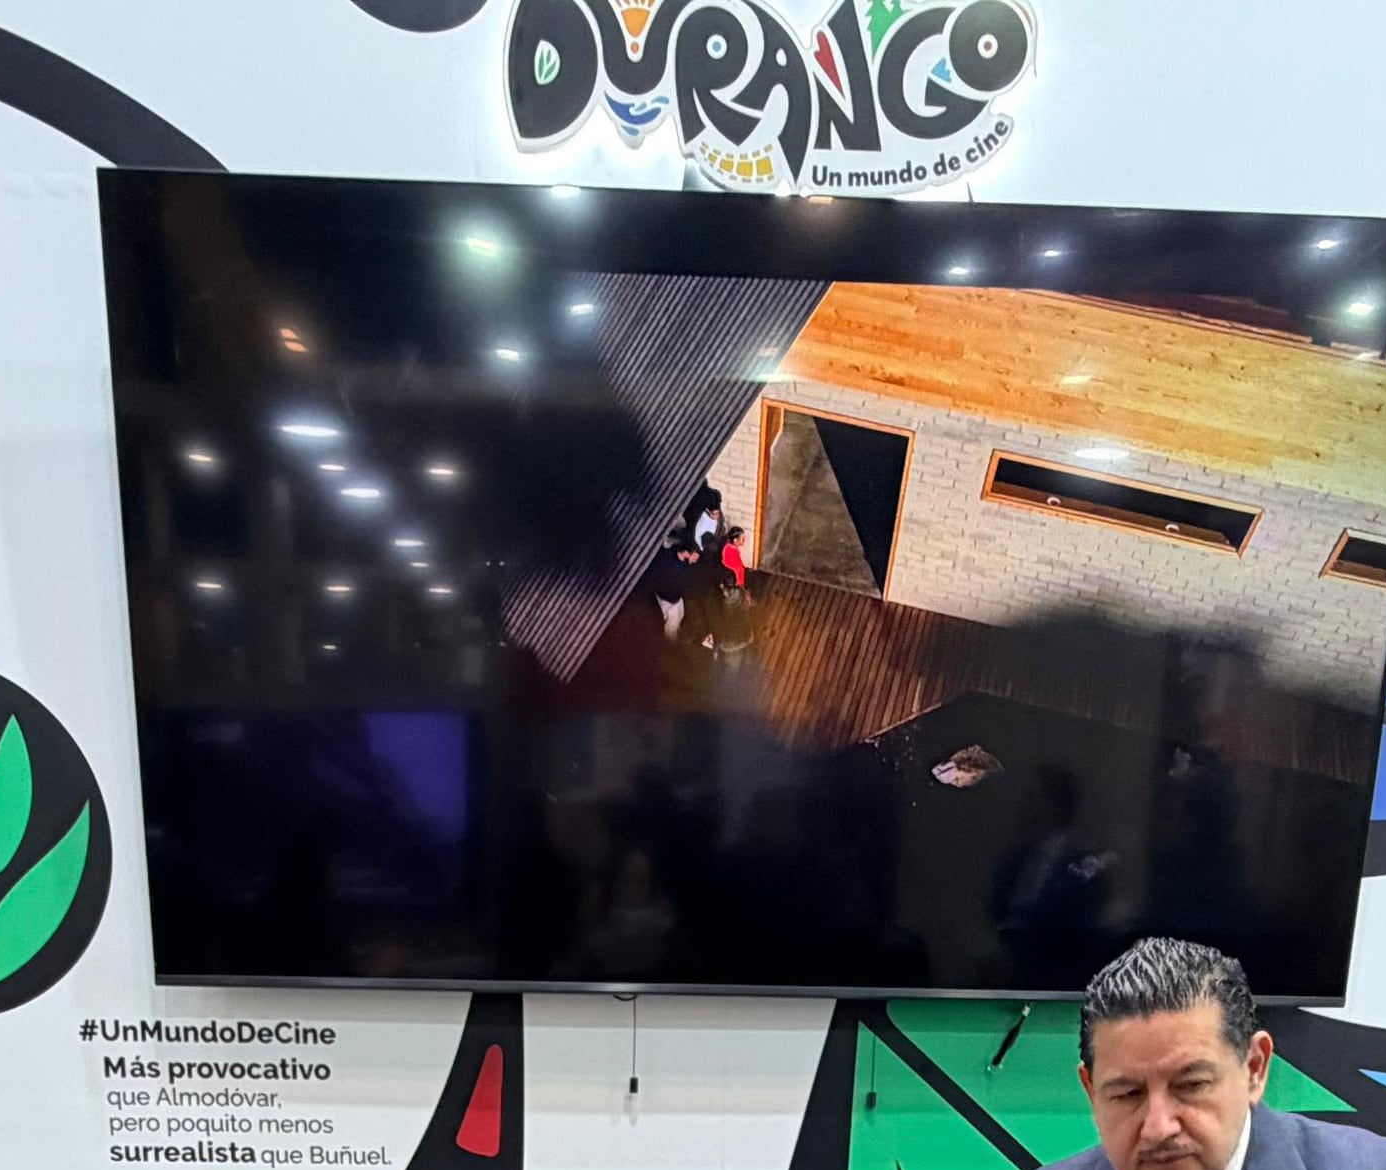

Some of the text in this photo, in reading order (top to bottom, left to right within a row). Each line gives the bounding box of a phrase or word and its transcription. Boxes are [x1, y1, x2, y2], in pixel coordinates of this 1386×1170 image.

[512, 0, 1028, 183] DURANGO
[813, 119, 1009, 187] Un mundo de cine
[79, 1020, 337, 1045] #UnMundoDeCine
[103, 1055, 331, 1084] Más provocativo
[107, 1087, 282, 1110] que Almodóvar,
[109, 1114, 334, 1137] pero poquito menos
[110, 1142, 392, 1168] surrealista que Buñuel.
